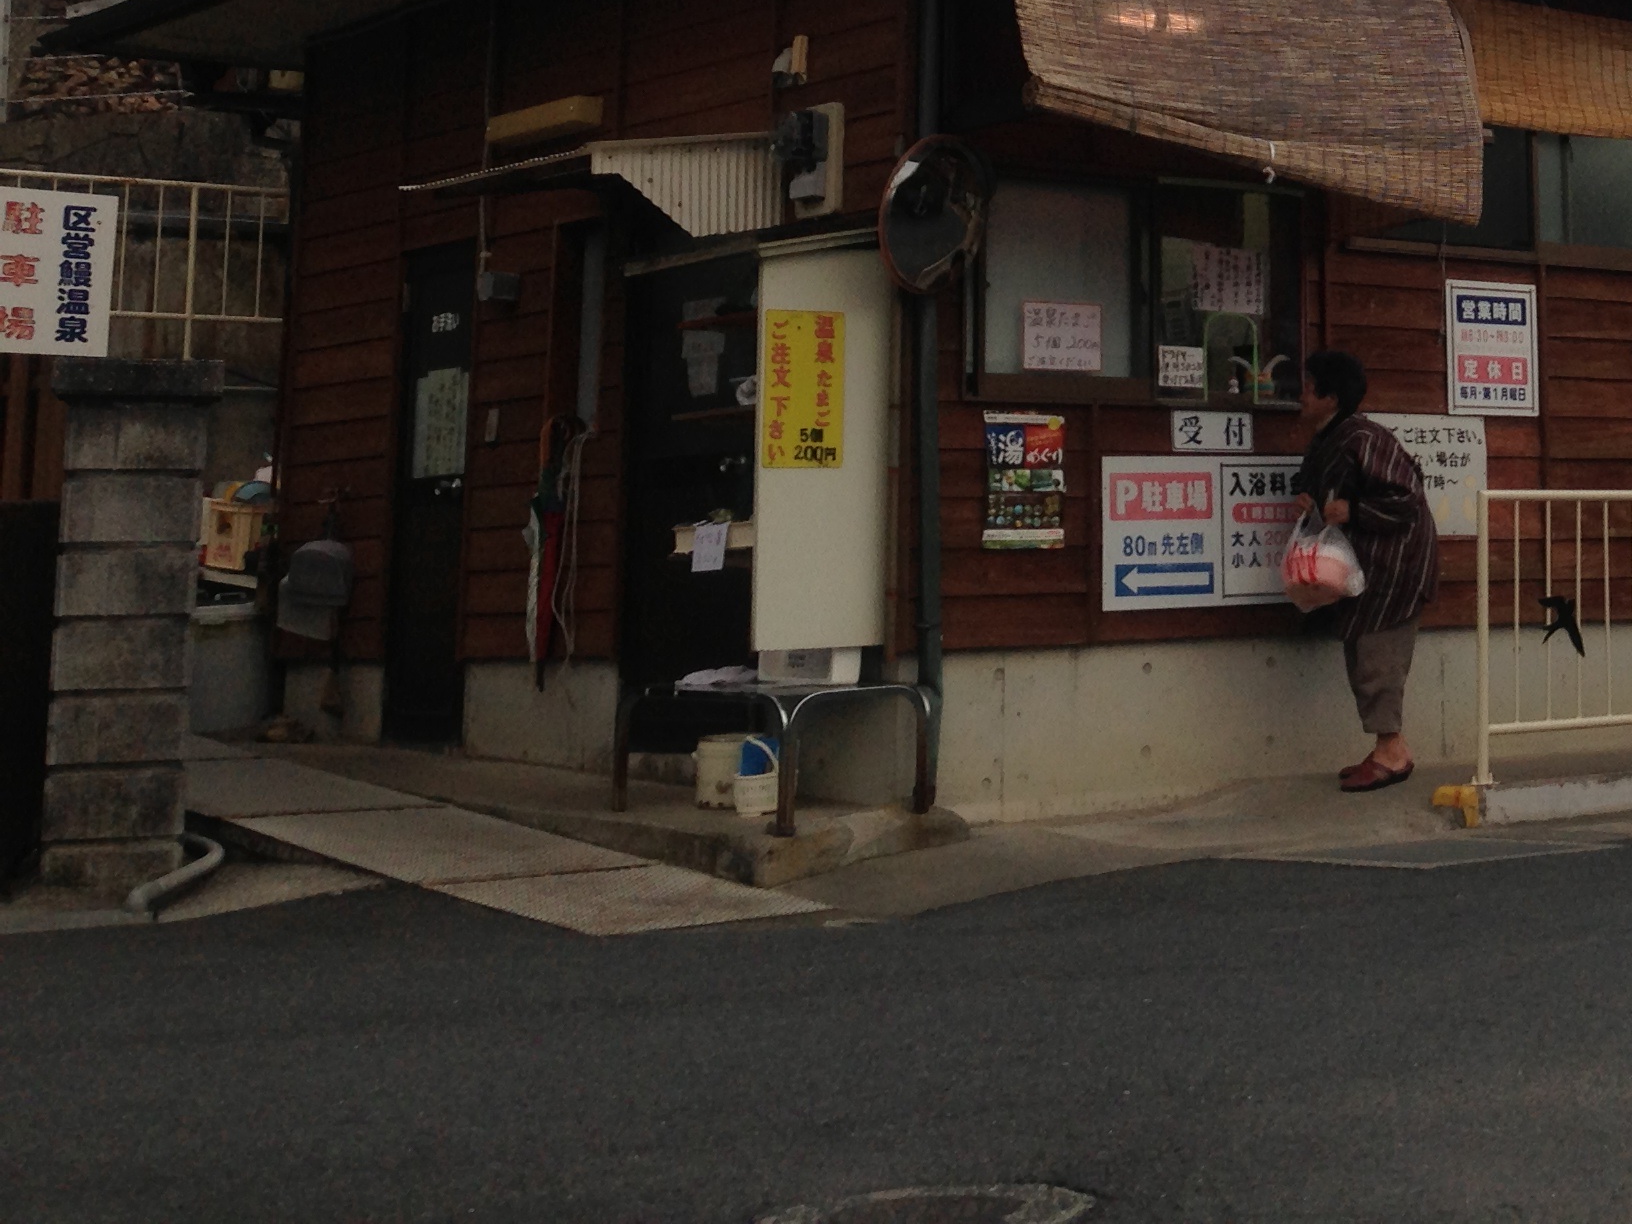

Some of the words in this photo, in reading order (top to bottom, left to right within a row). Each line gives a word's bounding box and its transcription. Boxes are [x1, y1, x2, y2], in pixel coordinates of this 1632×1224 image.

[55, 205, 97, 343] 区営鰻温泉
[1461, 300, 1522, 321] 営業時間
[814, 315, 836, 427] 温泉たまご
[1463, 359, 1523, 380] 定休日
[767, 319, 792, 464] ご注文下さい
[1178, 415, 1249, 447] 受付
[794, 445, 837, 463] 200円
[1232, 531, 1262, 547] 大人
[1232, 552, 1262, 568] 小人
